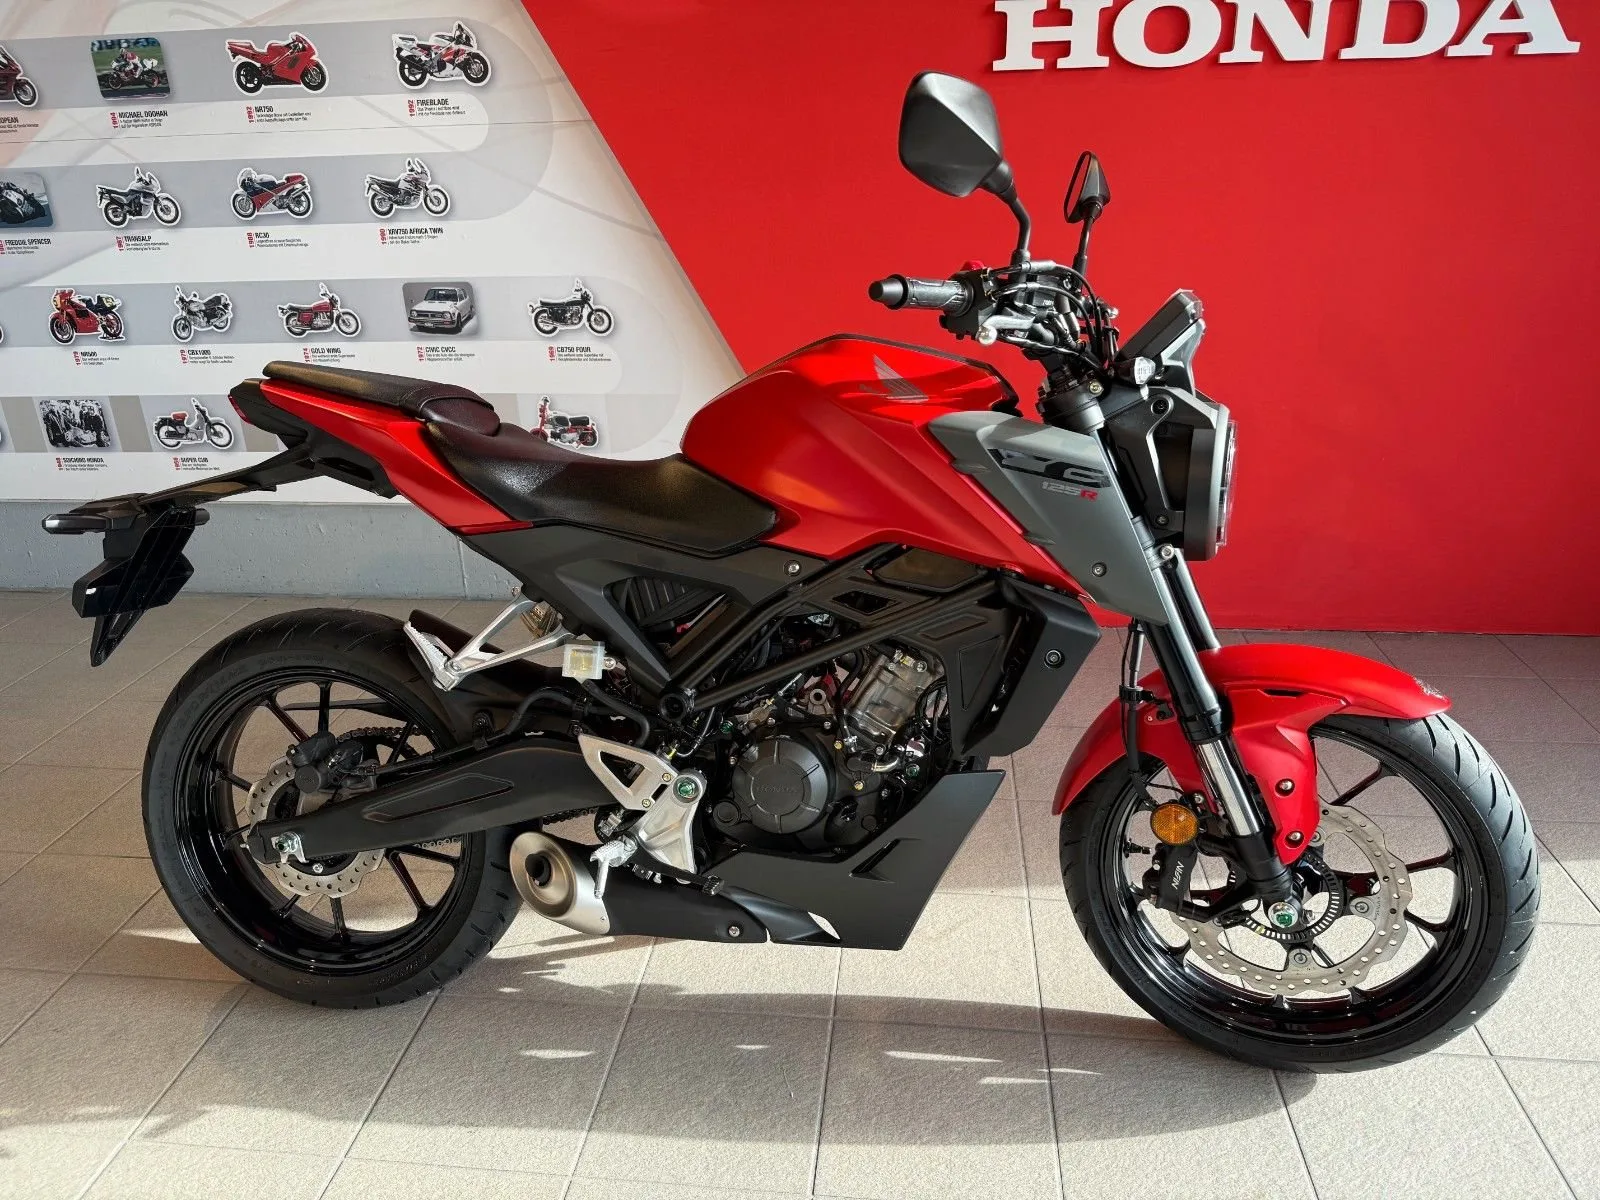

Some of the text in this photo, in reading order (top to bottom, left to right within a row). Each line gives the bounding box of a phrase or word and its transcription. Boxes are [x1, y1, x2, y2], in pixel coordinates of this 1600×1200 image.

[992, 0, 1581, 71] HONDA
[416, 98, 449, 106] FIREBLADE
[118, 111, 143, 119] MICHAEL
[1042, 481, 1098, 501] 125R
